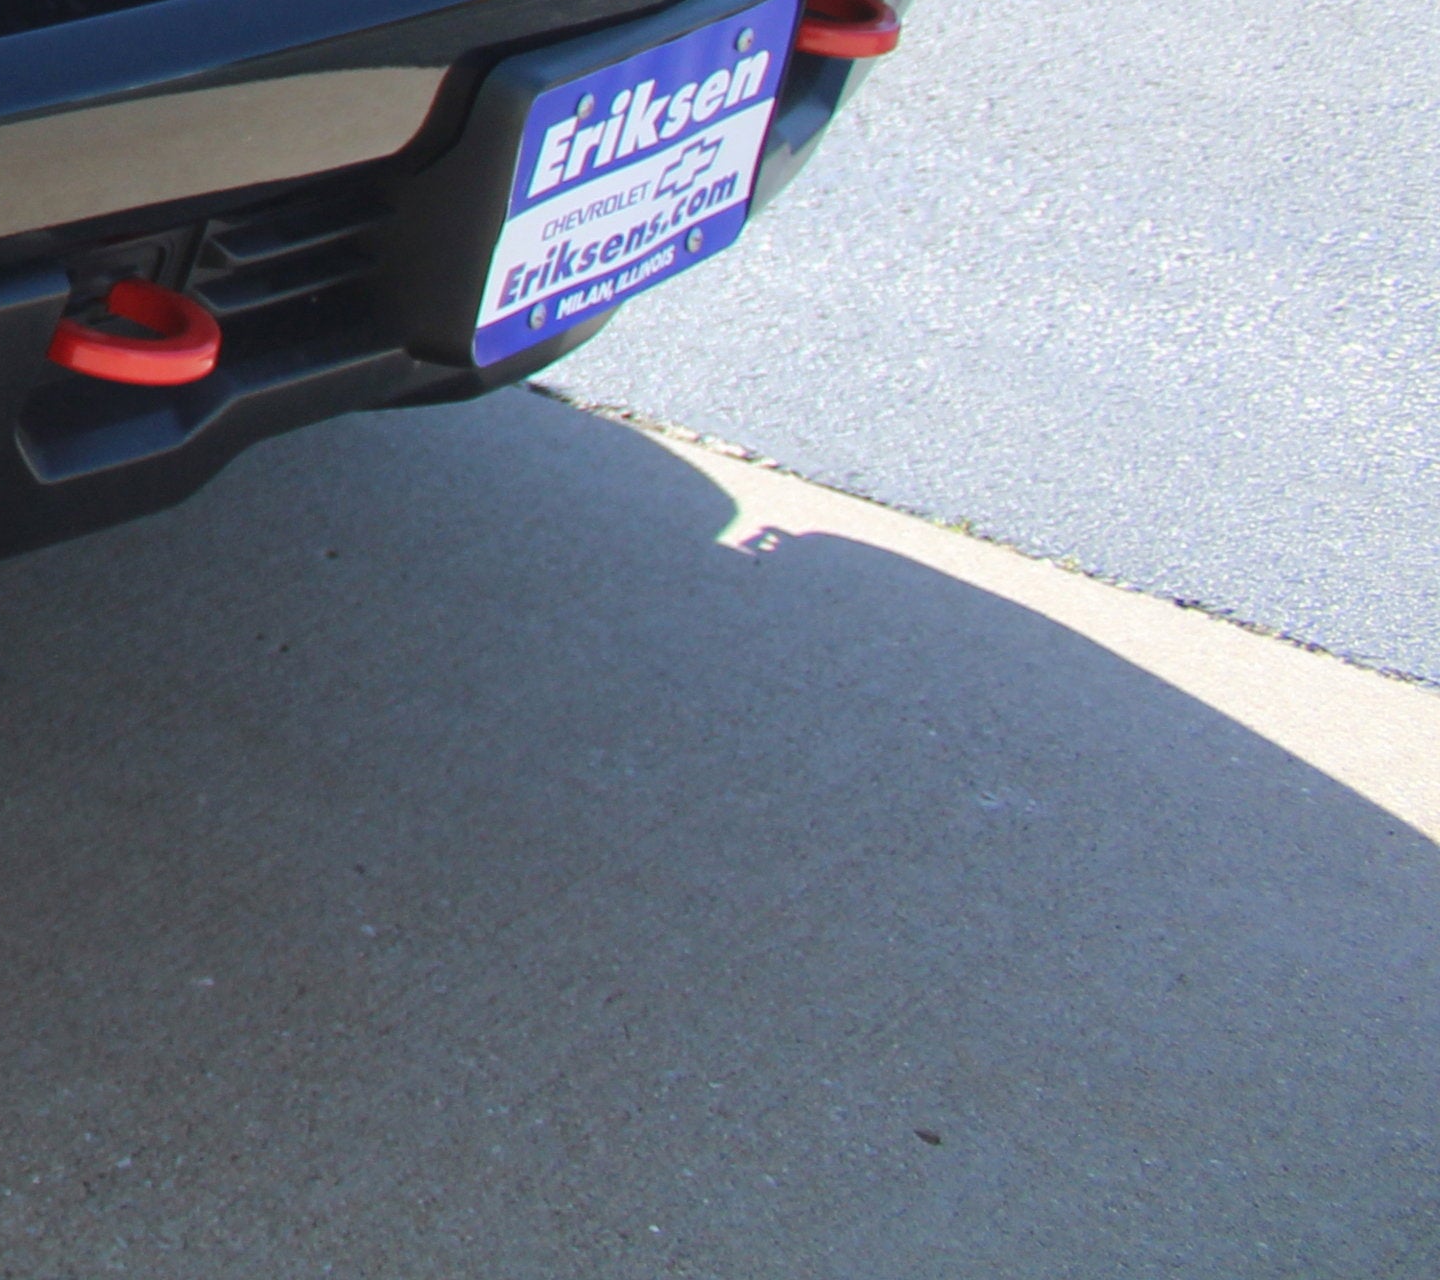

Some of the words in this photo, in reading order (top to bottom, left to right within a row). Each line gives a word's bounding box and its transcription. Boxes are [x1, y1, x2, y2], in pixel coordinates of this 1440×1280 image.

[526, 49, 770, 200] Eriksen
[497, 171, 739, 310] Eriksens.com
[542, 180, 652, 241] CHEVROLET
[615, 245, 676, 294] ILLINOIS
